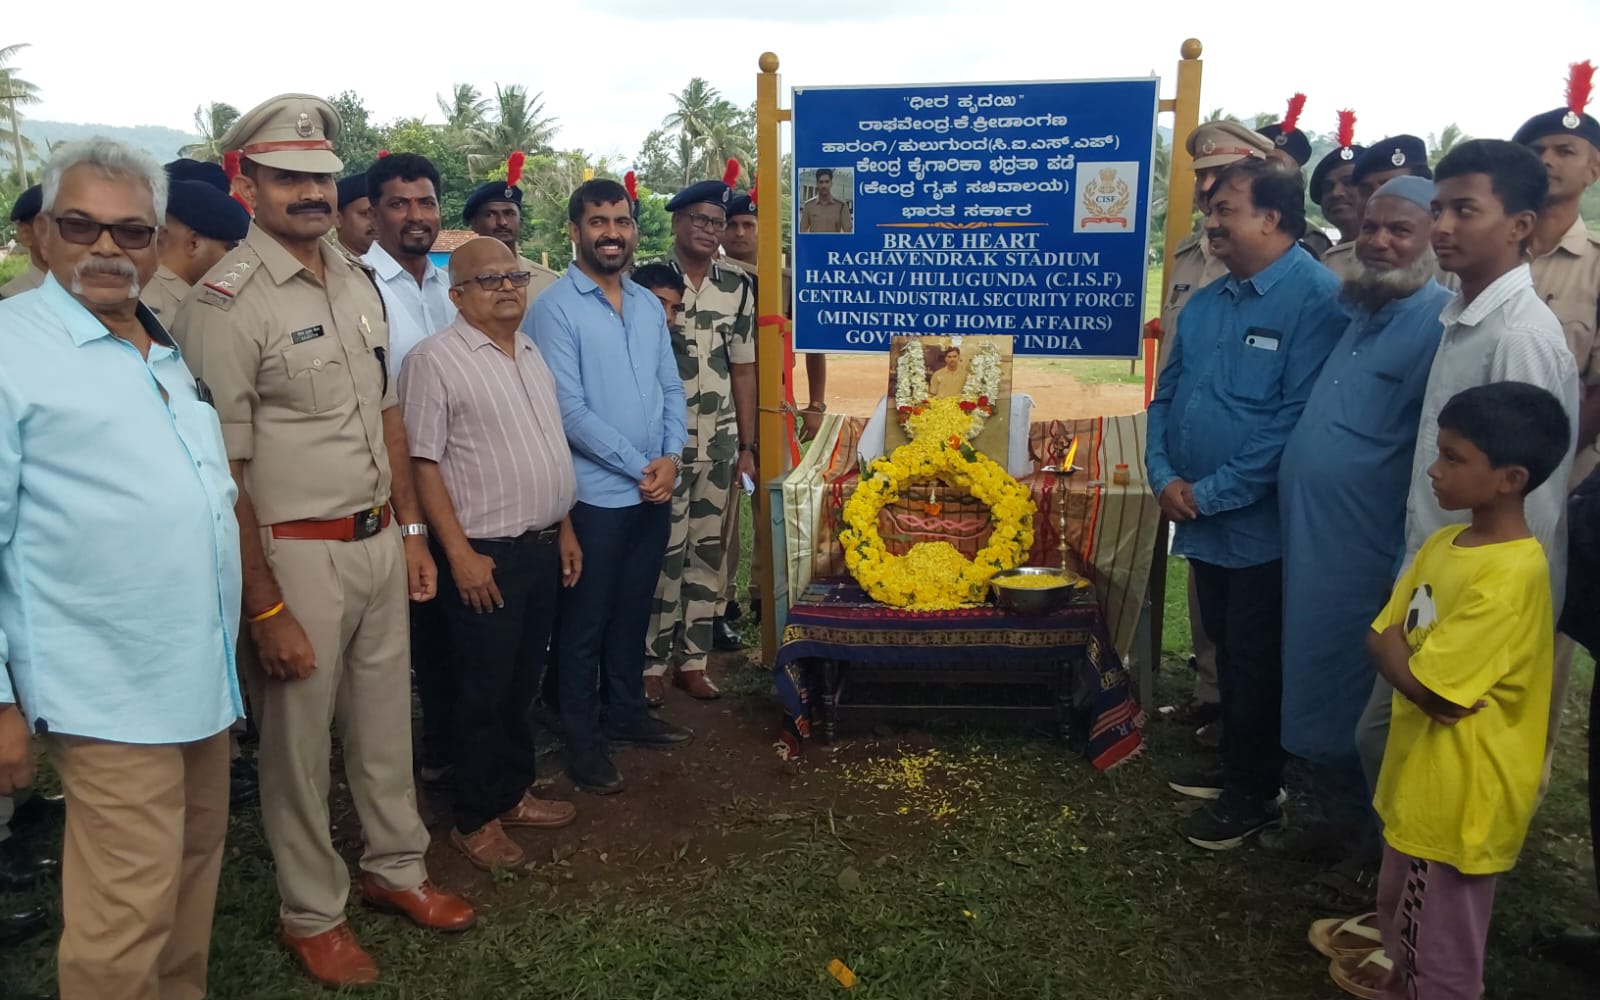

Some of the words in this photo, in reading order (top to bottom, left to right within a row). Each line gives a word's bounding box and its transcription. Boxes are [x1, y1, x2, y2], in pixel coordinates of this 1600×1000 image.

[856, 156, 902, 178] ಕೇಂದ್ರ
[907, 156, 982, 181] ಕೈಗಾರಿಕಾ
[988, 154, 1039, 176] ಭದ್ರತಾ
[1046, 153, 1076, 171] ಪಡೆ
[923, 180, 958, 201] ಗೃಹ
[901, 203, 956, 219] ಭಾರತ
[963, 203, 1033, 218] ಸರ್ಕಾರ
[883, 233, 955, 249] BRAVE
[961, 232, 1040, 249] HEART
[827, 251, 998, 267] RAGHAVENDRA.K
[1005, 252, 1100, 267] STADIUM
[805, 269, 895, 286] HARANGI
[910, 271, 1037, 287] HULUGUNDA
[1045, 272, 1122, 290] (C.I.S.F)
[798, 288, 876, 304] CENTRAL
[878, 290, 980, 307] INDUSTRIAL
[982, 292, 1071, 307] SECURITY
[1074, 292, 1136, 308] FORCE
[817, 308, 920, 329] (MINISTRY
[923, 313, 951, 328] OF
[955, 314, 1016, 329] HOME
[1020, 314, 1113, 332] AFFAIRS)
[1023, 334, 1084, 350] INDIA
